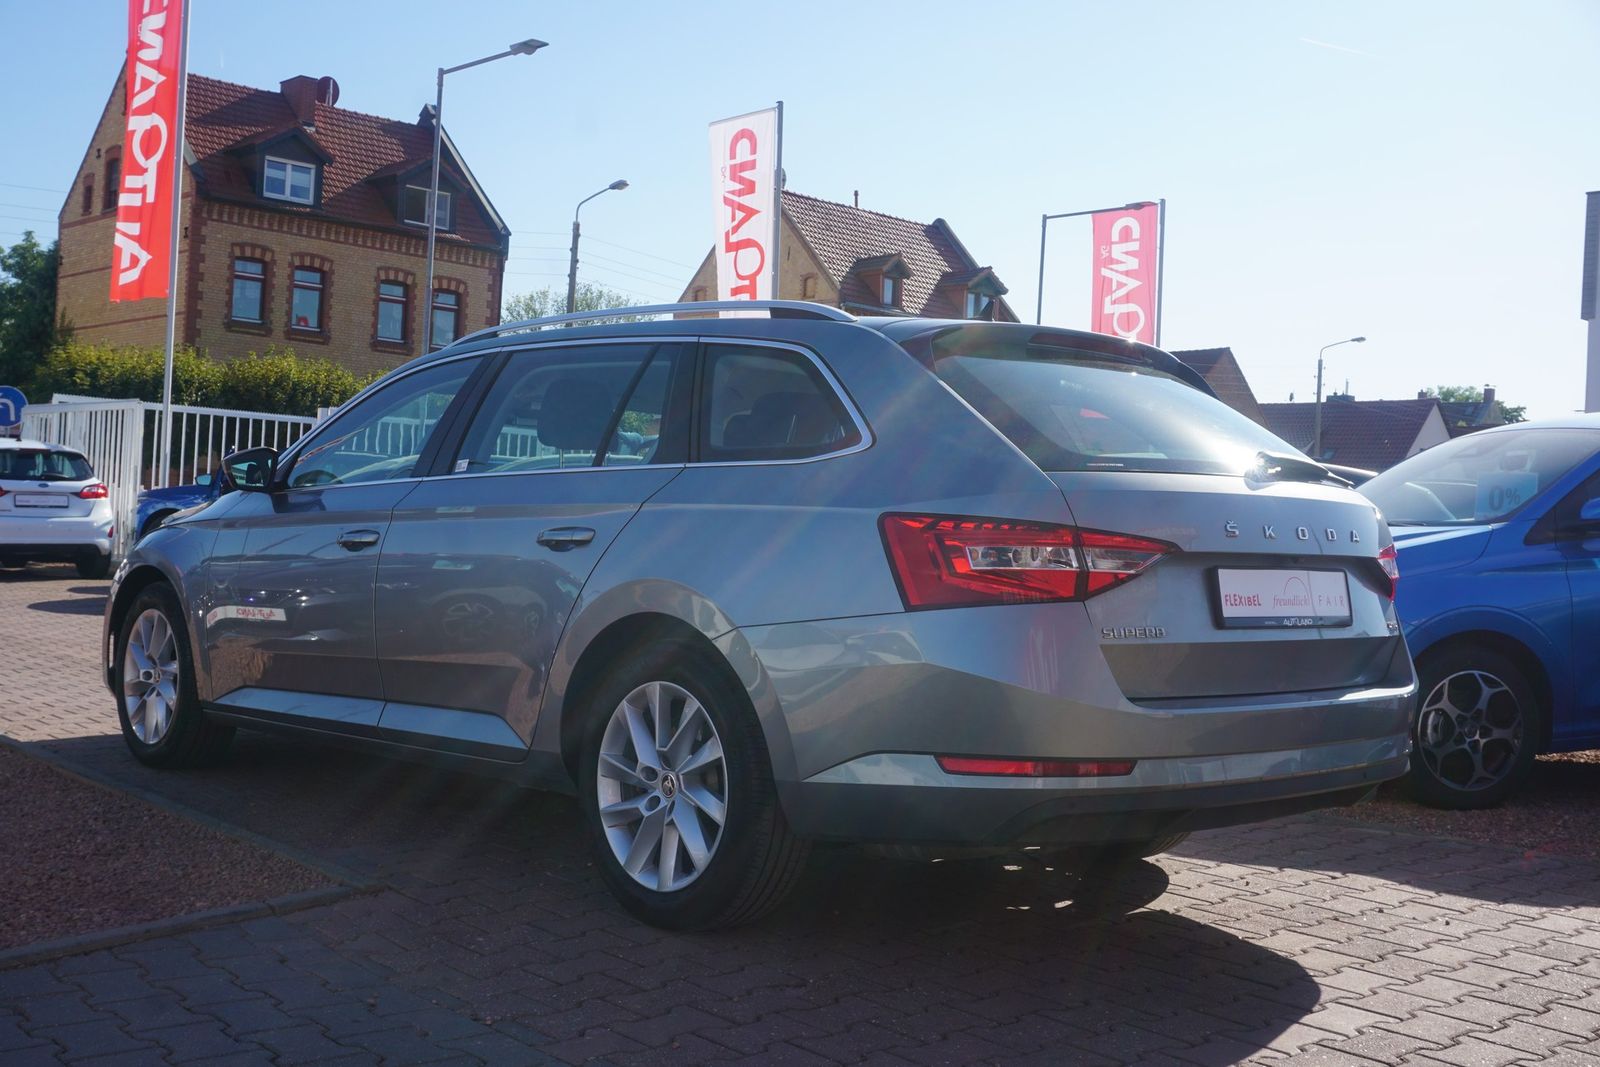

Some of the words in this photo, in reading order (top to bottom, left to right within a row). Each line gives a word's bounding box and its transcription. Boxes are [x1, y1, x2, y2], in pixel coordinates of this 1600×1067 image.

[1488, 485, 1521, 511] 0%
[1224, 520, 1361, 544] ŠKODA
[1224, 593, 1262, 607] FLEXIBEL
[1101, 626, 1167, 640] SUPERB
